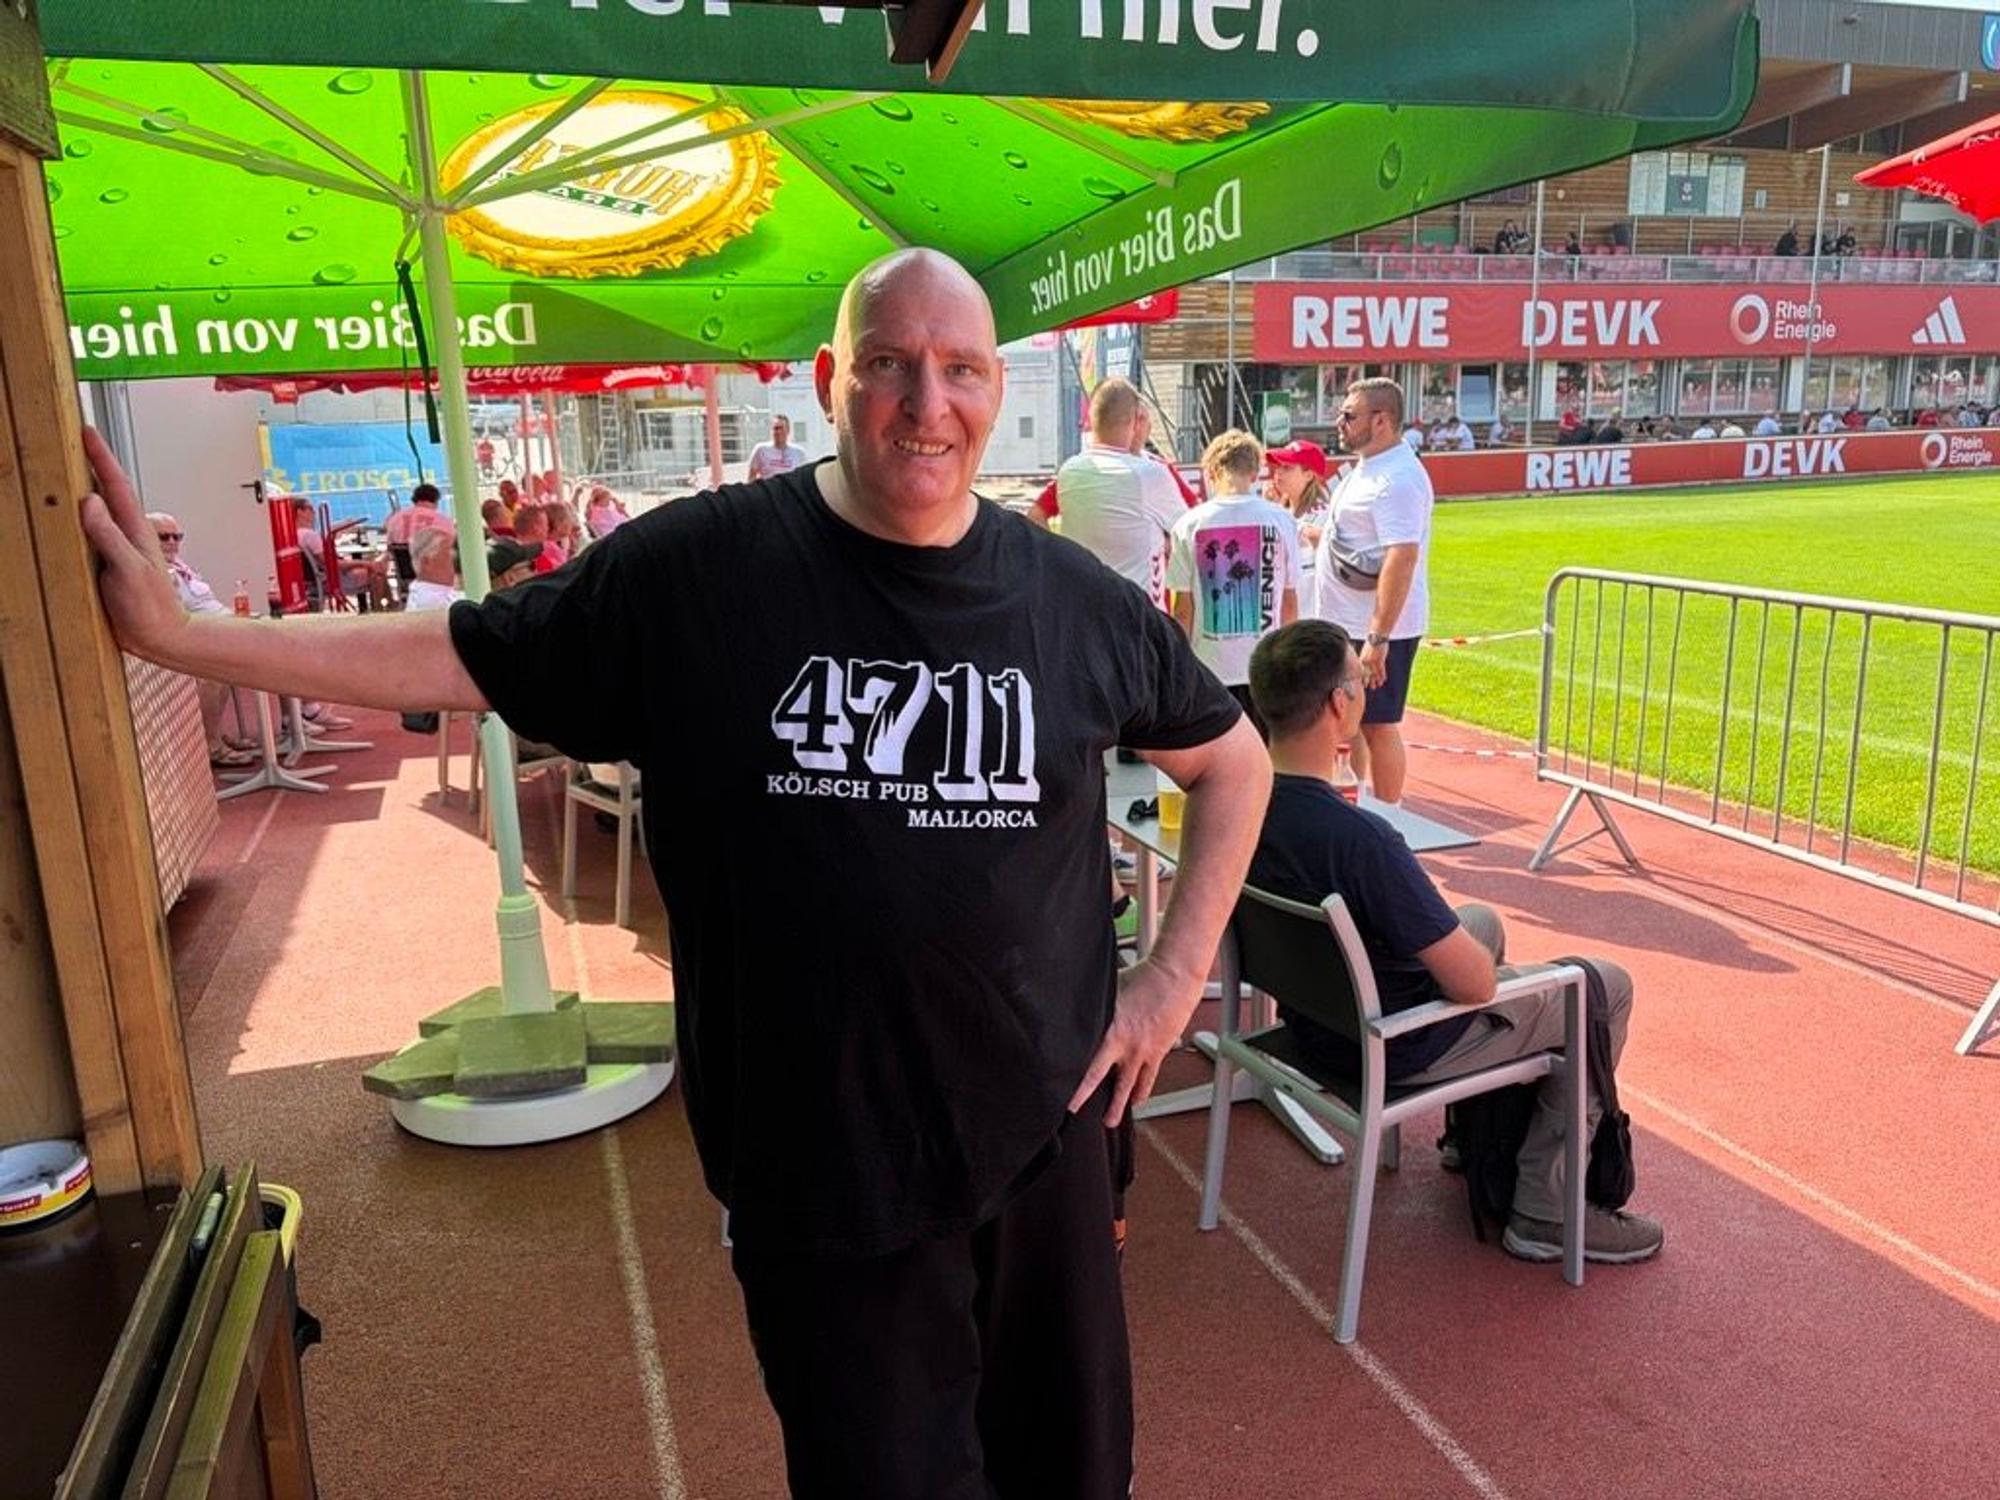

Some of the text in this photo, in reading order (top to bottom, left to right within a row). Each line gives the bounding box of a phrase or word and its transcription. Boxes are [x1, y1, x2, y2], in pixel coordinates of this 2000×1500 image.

[1292, 296, 1662, 348] REWE DEVK
[1775, 300, 1822, 319] Rhein
[1773, 320, 1837, 343] Energie
[1950, 436, 1984, 450] Rhein
[1525, 439, 1847, 489] REWE DEVK
[1949, 449, 1994, 467] Energie
[1261, 525, 1276, 632] VENICE
[771, 655, 1041, 802] 4711
[766, 772, 929, 802] KÖLSCH PUB
[907, 808, 1038, 828] MALLORCA
